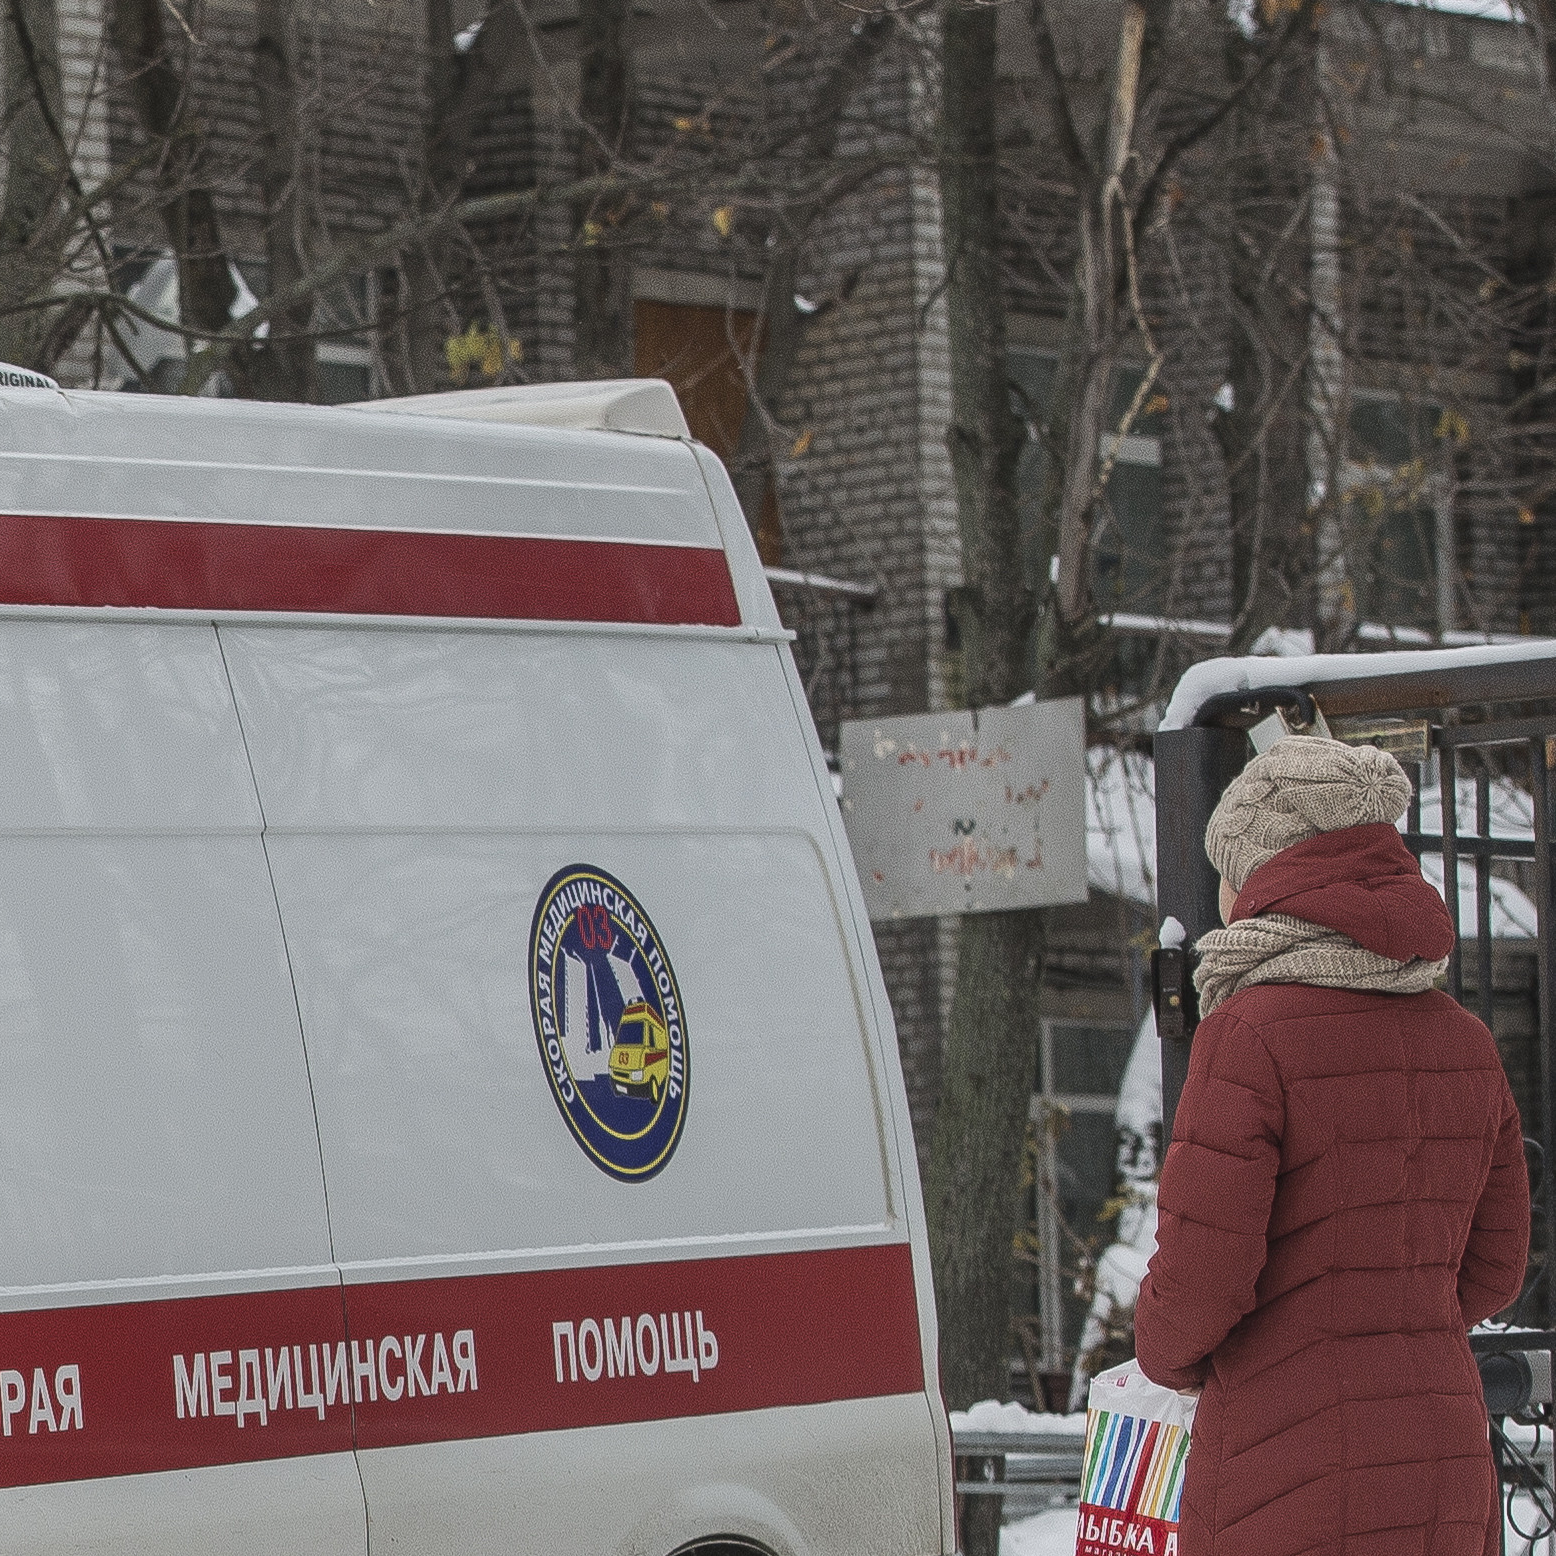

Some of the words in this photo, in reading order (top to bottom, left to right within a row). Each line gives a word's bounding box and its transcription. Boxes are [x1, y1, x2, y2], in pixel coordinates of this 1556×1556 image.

[539, 881, 649, 966] МЕДИЦИНСКАЯ
[577, 904, 613, 950] 03
[539, 971, 575, 1104] СКОРАЯ
[647, 947, 683, 1100] ПОМОЩЬ
[172, 1329, 479, 1428] МЕДИЦИНСКАЯ
[552, 1310, 720, 1384] ПОМОЩЬ
